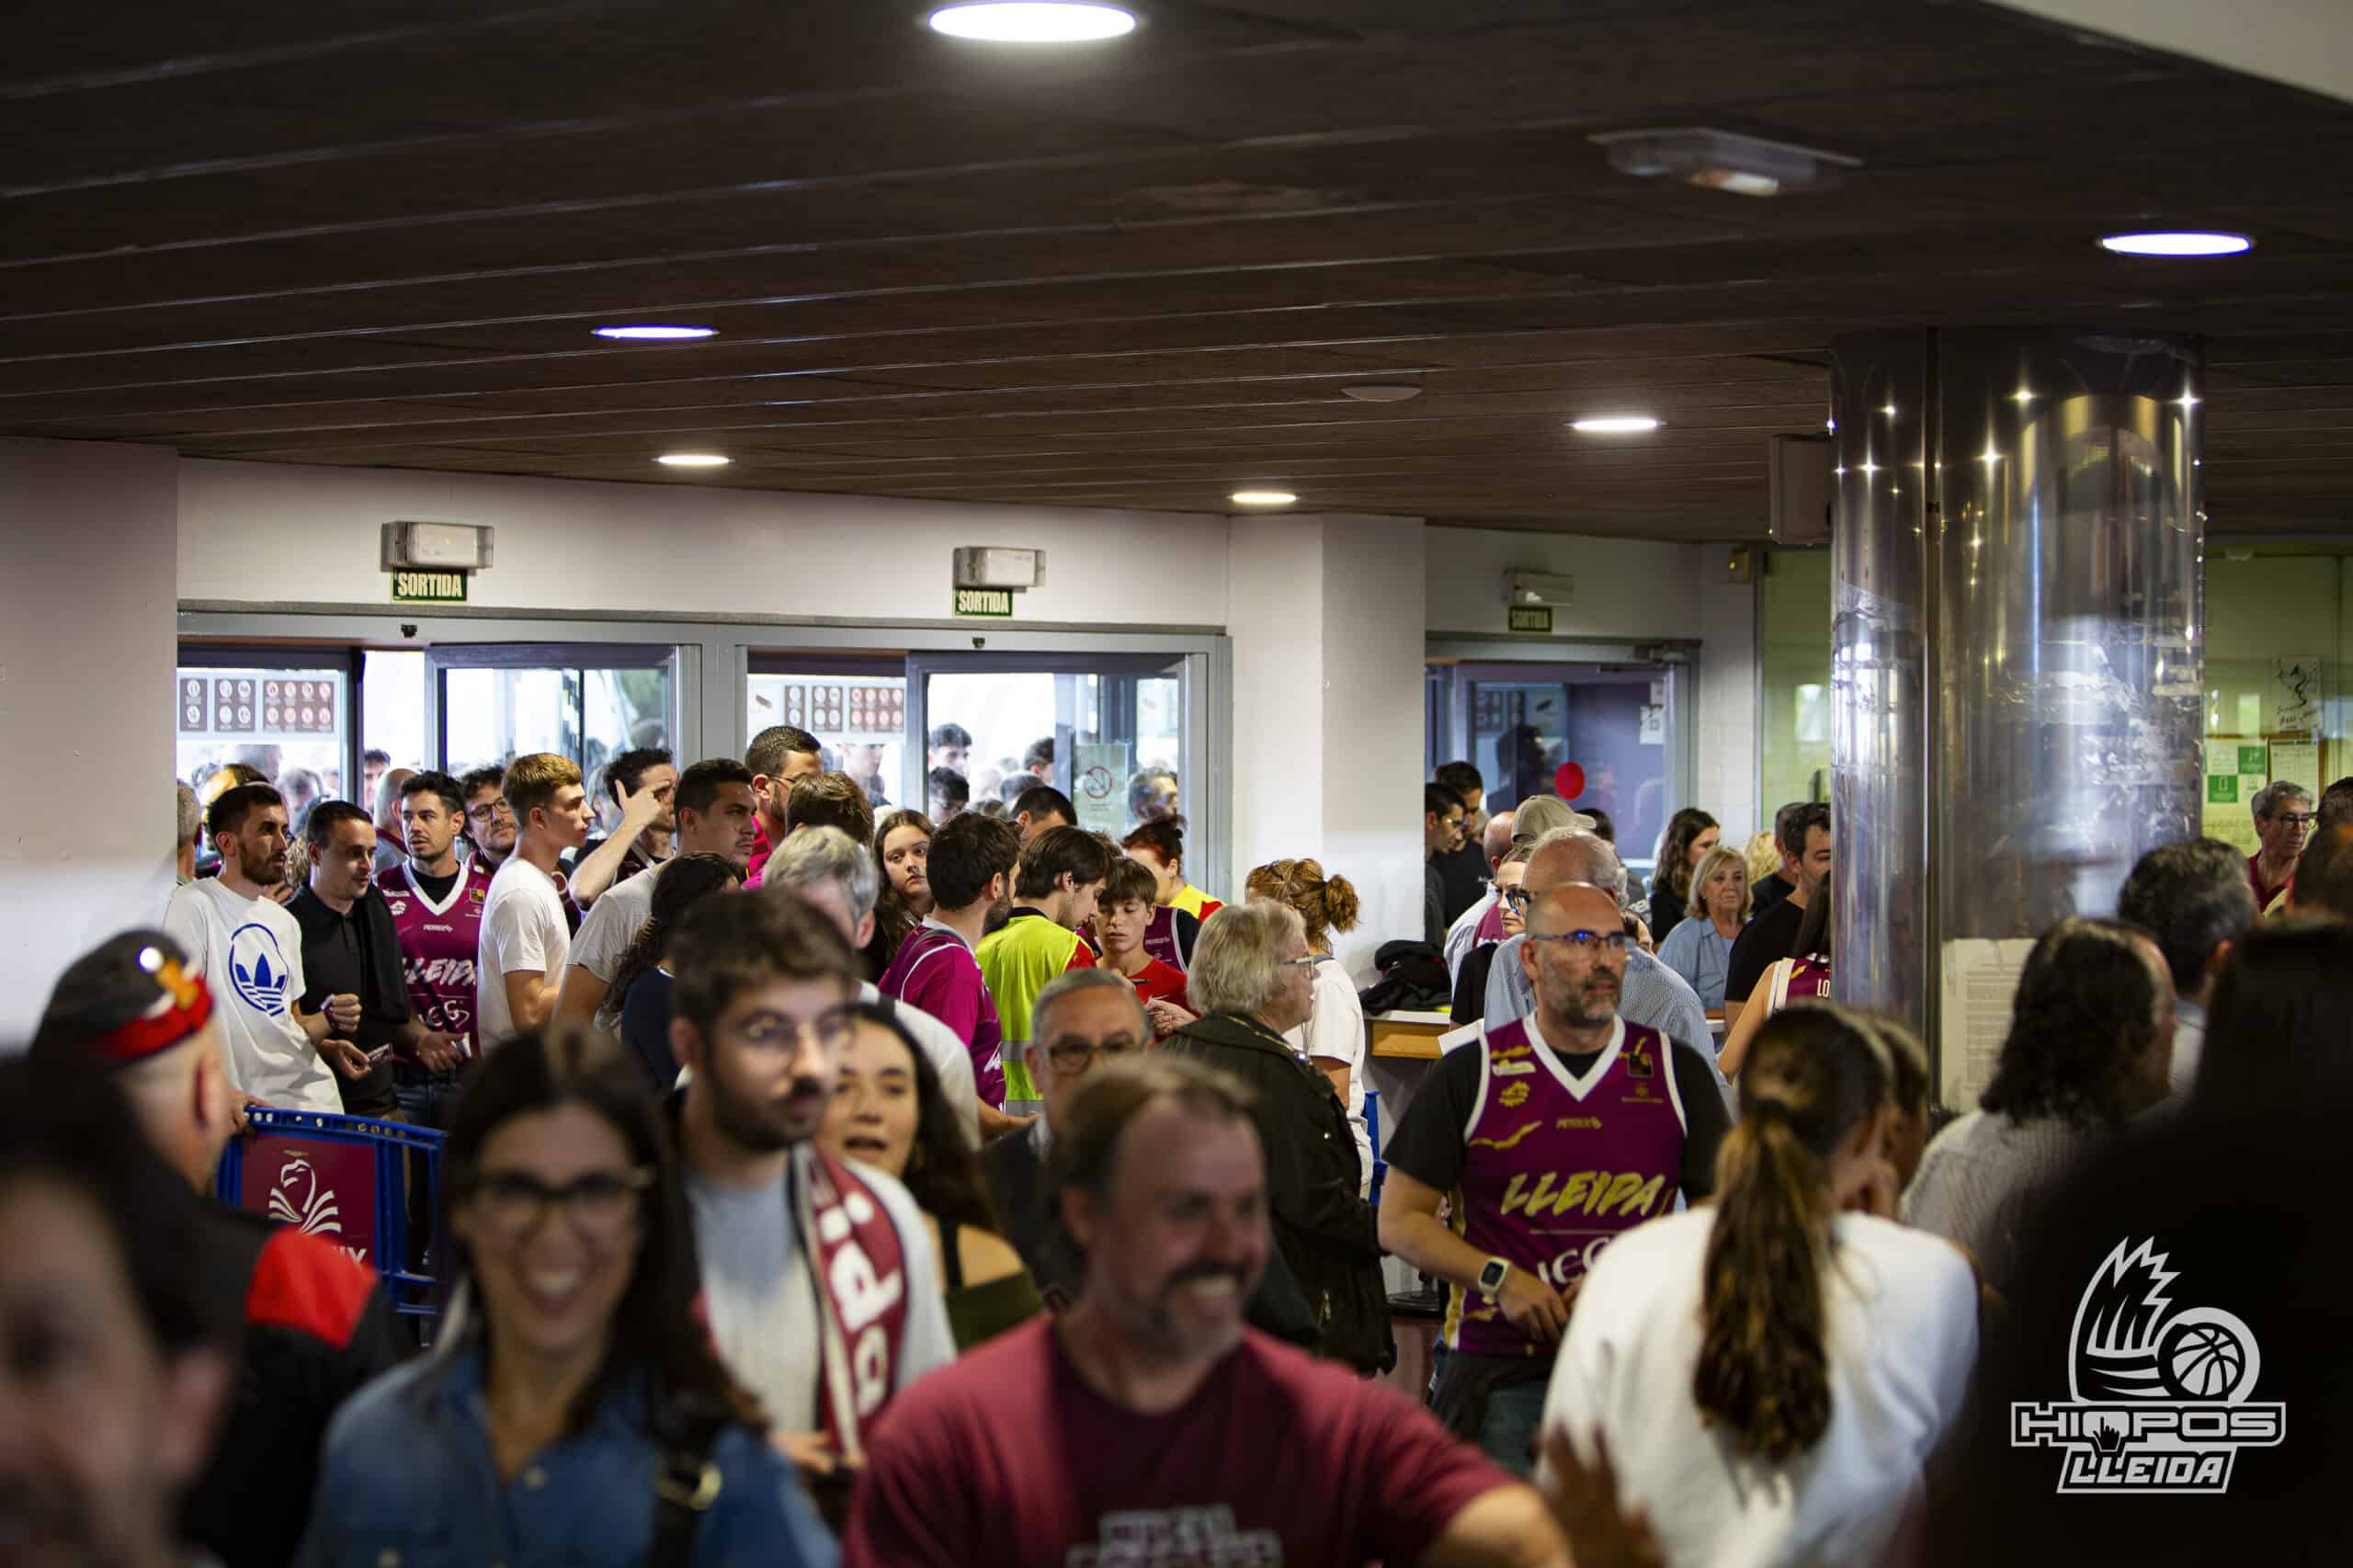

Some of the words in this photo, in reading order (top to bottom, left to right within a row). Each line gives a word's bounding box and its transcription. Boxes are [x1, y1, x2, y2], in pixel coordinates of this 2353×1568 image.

[397, 572, 462, 597] SORTIDA
[958, 590, 1009, 612] SORTIDA
[1500, 1170, 1666, 1216] LLEIDA
